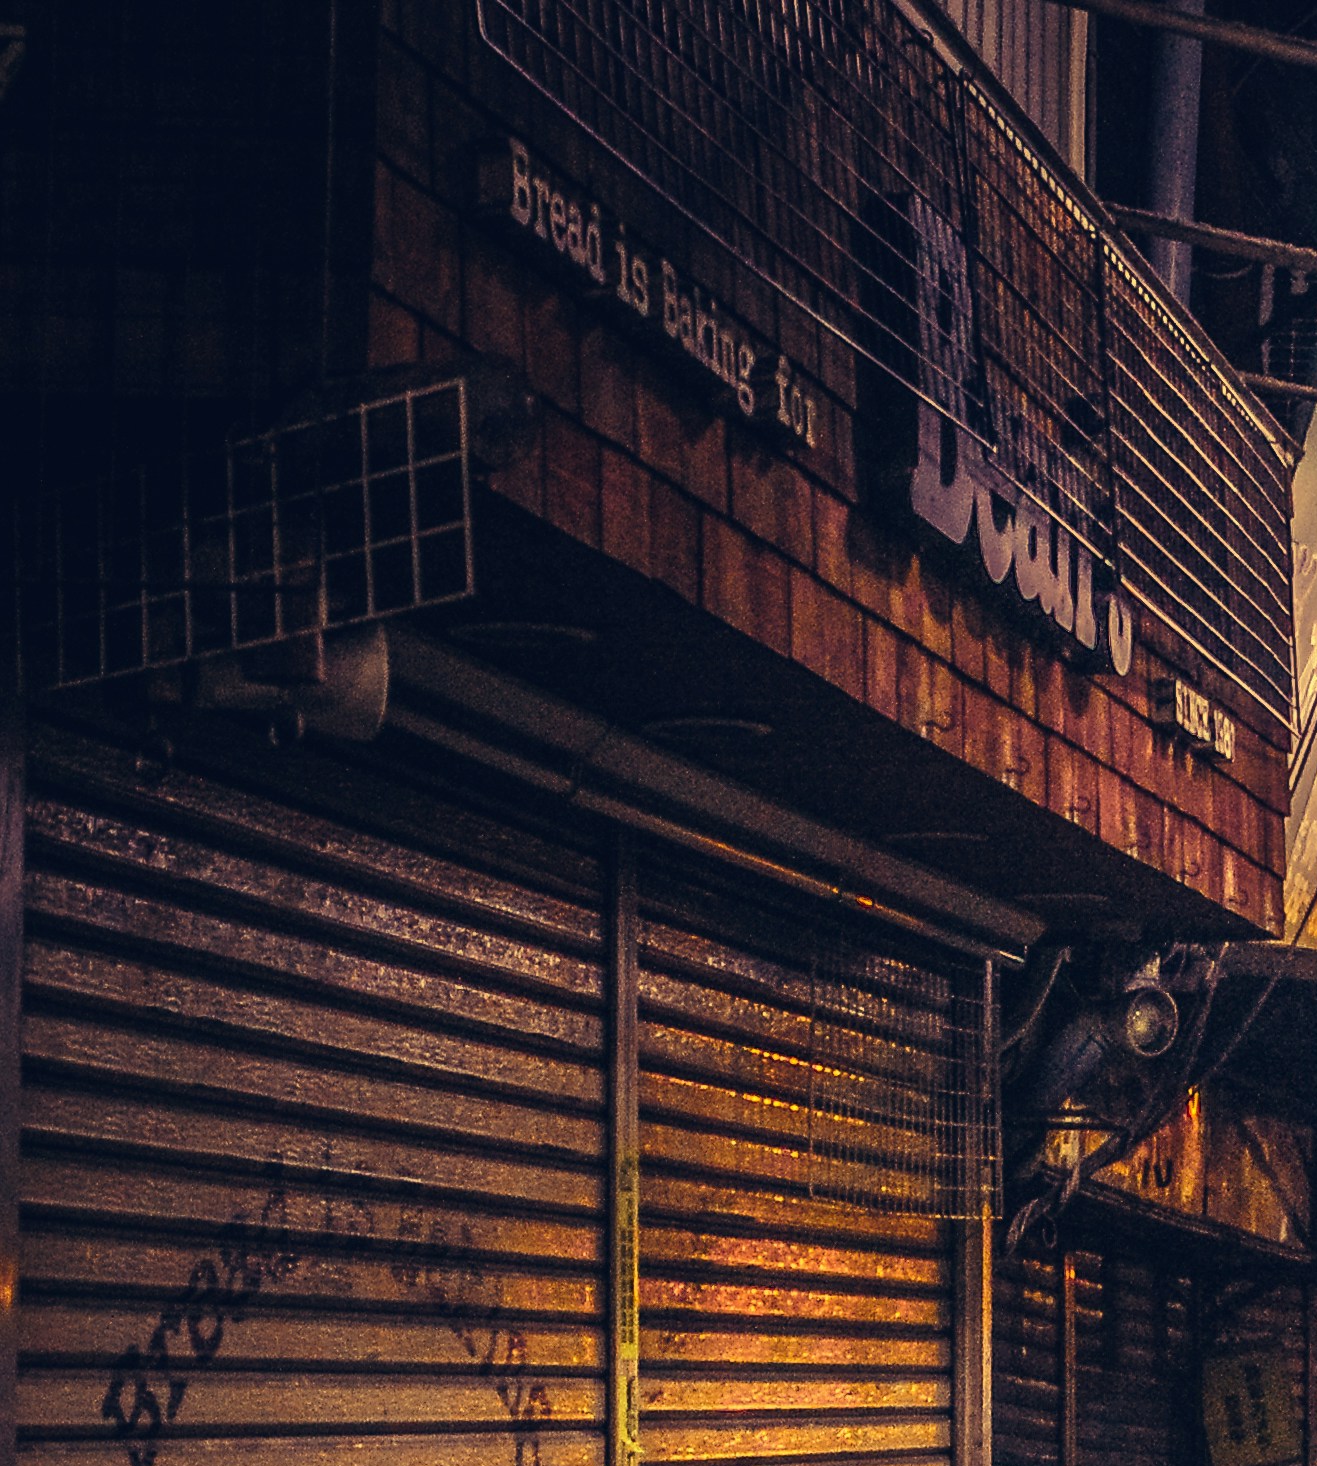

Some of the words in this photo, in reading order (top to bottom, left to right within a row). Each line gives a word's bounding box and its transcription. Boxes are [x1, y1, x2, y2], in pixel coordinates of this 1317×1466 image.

[508, 136, 608, 285] Bread
[615, 223, 649, 317] is
[660, 256, 757, 418] Baking
